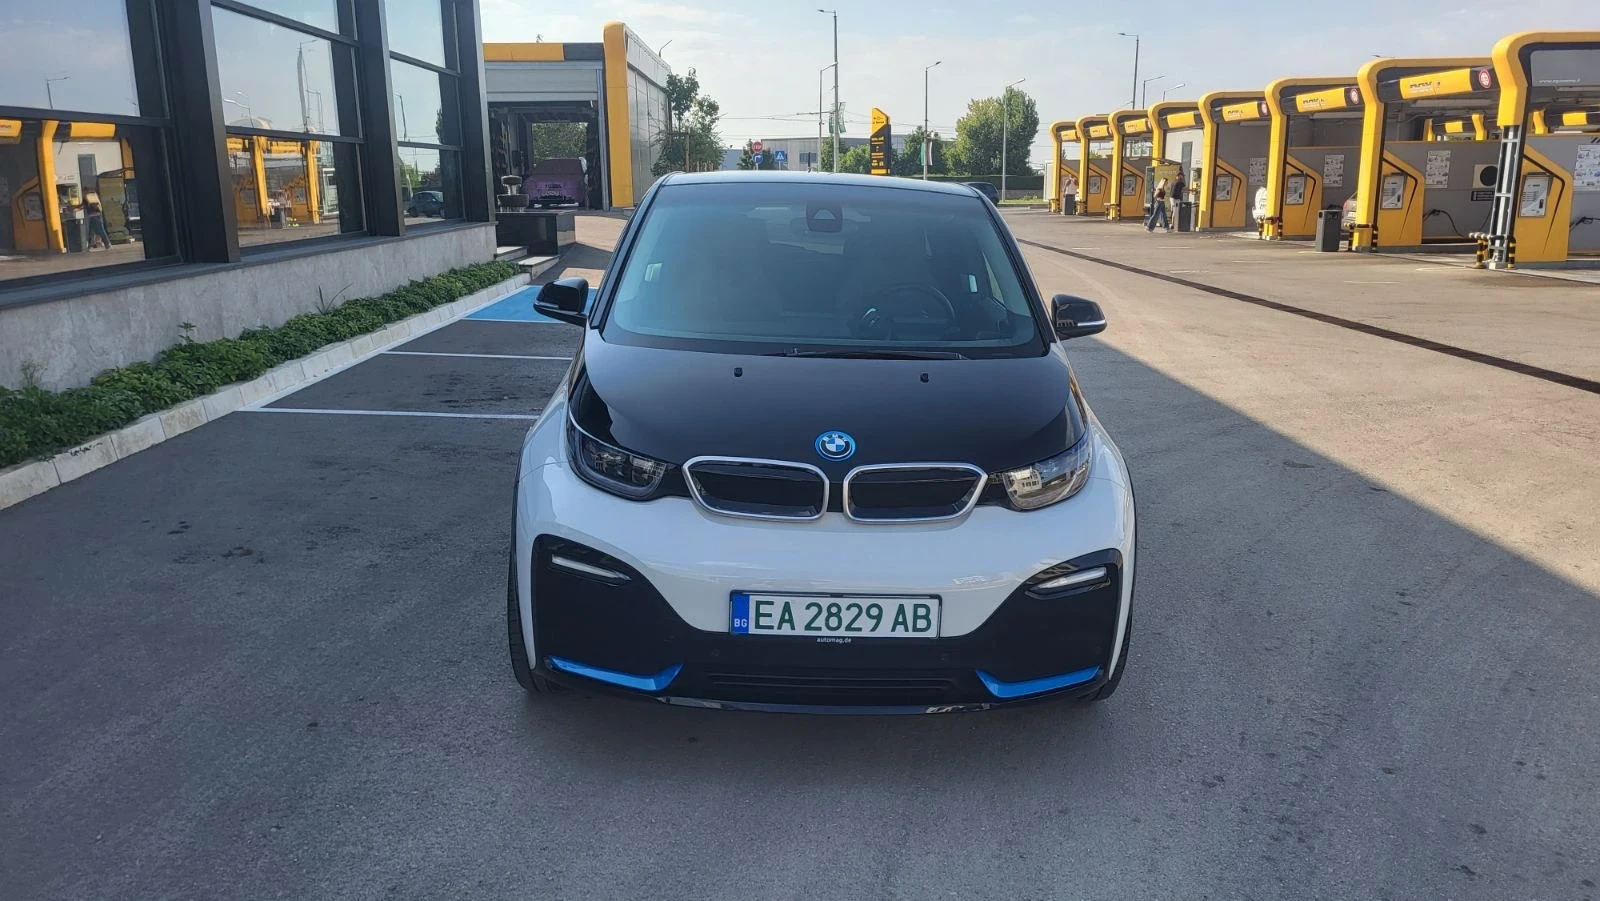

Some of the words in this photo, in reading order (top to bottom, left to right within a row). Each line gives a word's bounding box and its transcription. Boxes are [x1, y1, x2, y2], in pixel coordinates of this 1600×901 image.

[734, 618, 748, 628] BG
[754, 600, 796, 631] EA
[804, 602, 884, 633] 2829
[890, 603, 932, 633] AB
